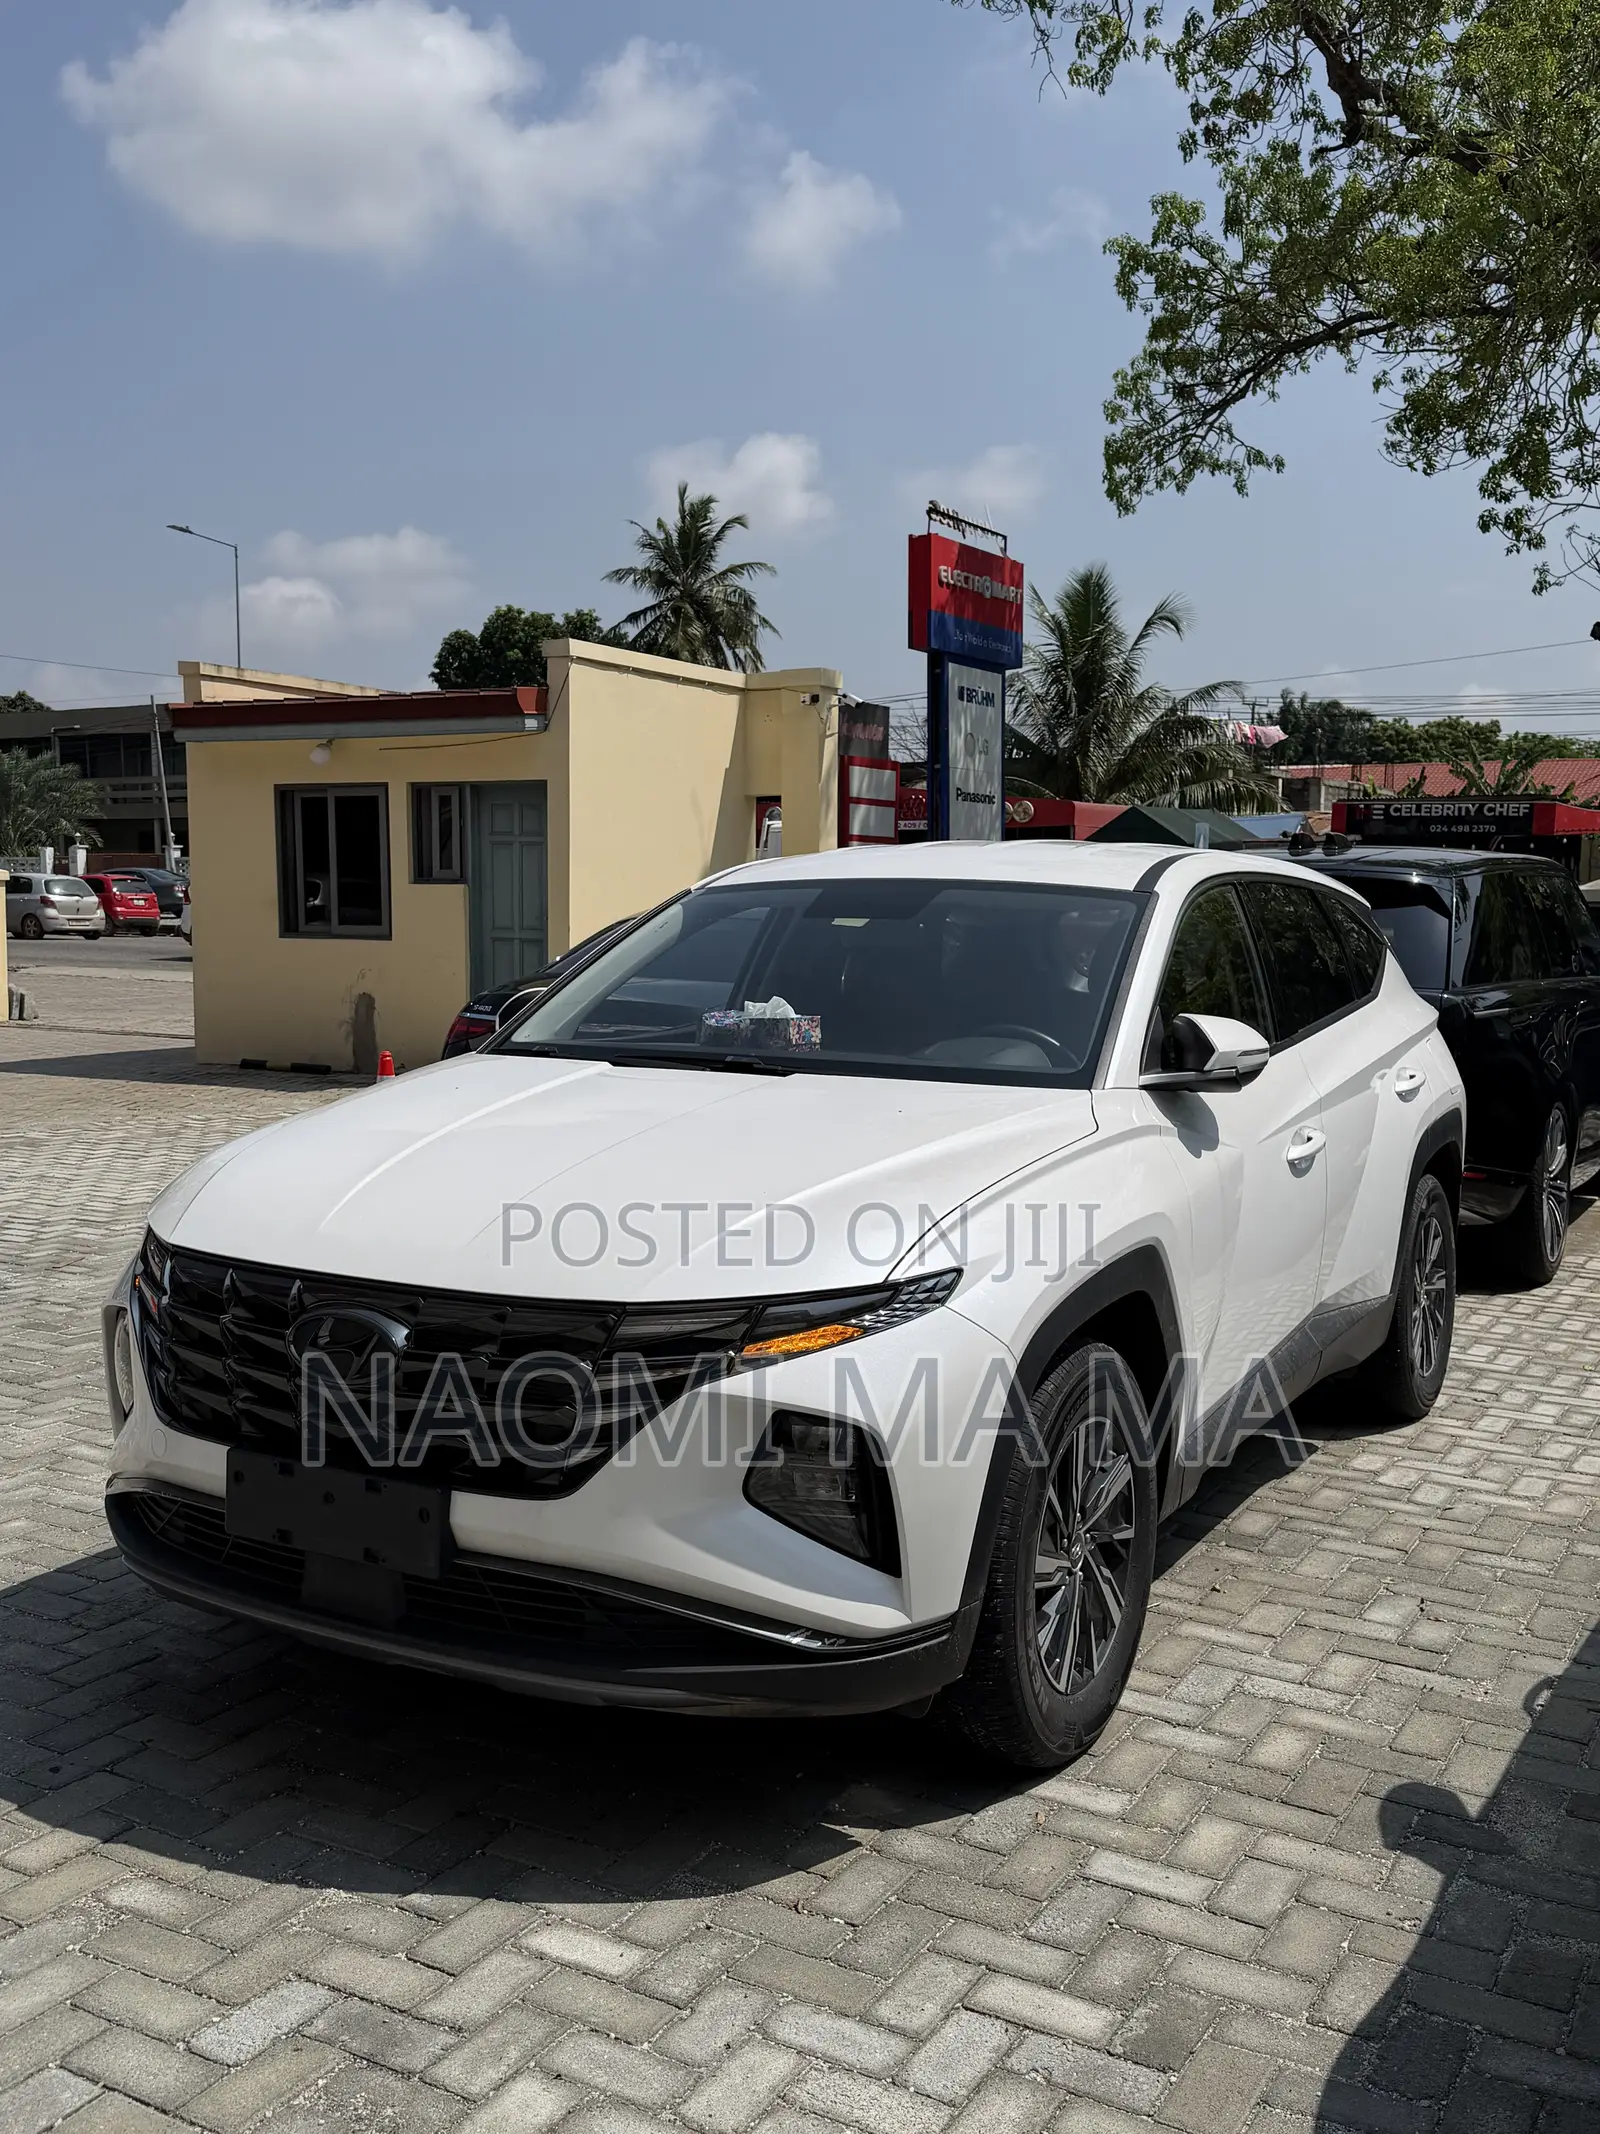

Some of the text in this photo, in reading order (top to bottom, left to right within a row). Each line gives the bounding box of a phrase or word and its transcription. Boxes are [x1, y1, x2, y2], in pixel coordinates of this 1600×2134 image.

[938, 565, 1022, 604] ELECTROMART
[967, 631, 983, 646] Wold
[956, 787, 996, 805] Panasonic
[1389, 803, 1479, 817] CELEBRITY
[1483, 803, 1530, 817] CHEF
[1429, 824, 1497, 833] 024 498 2370
